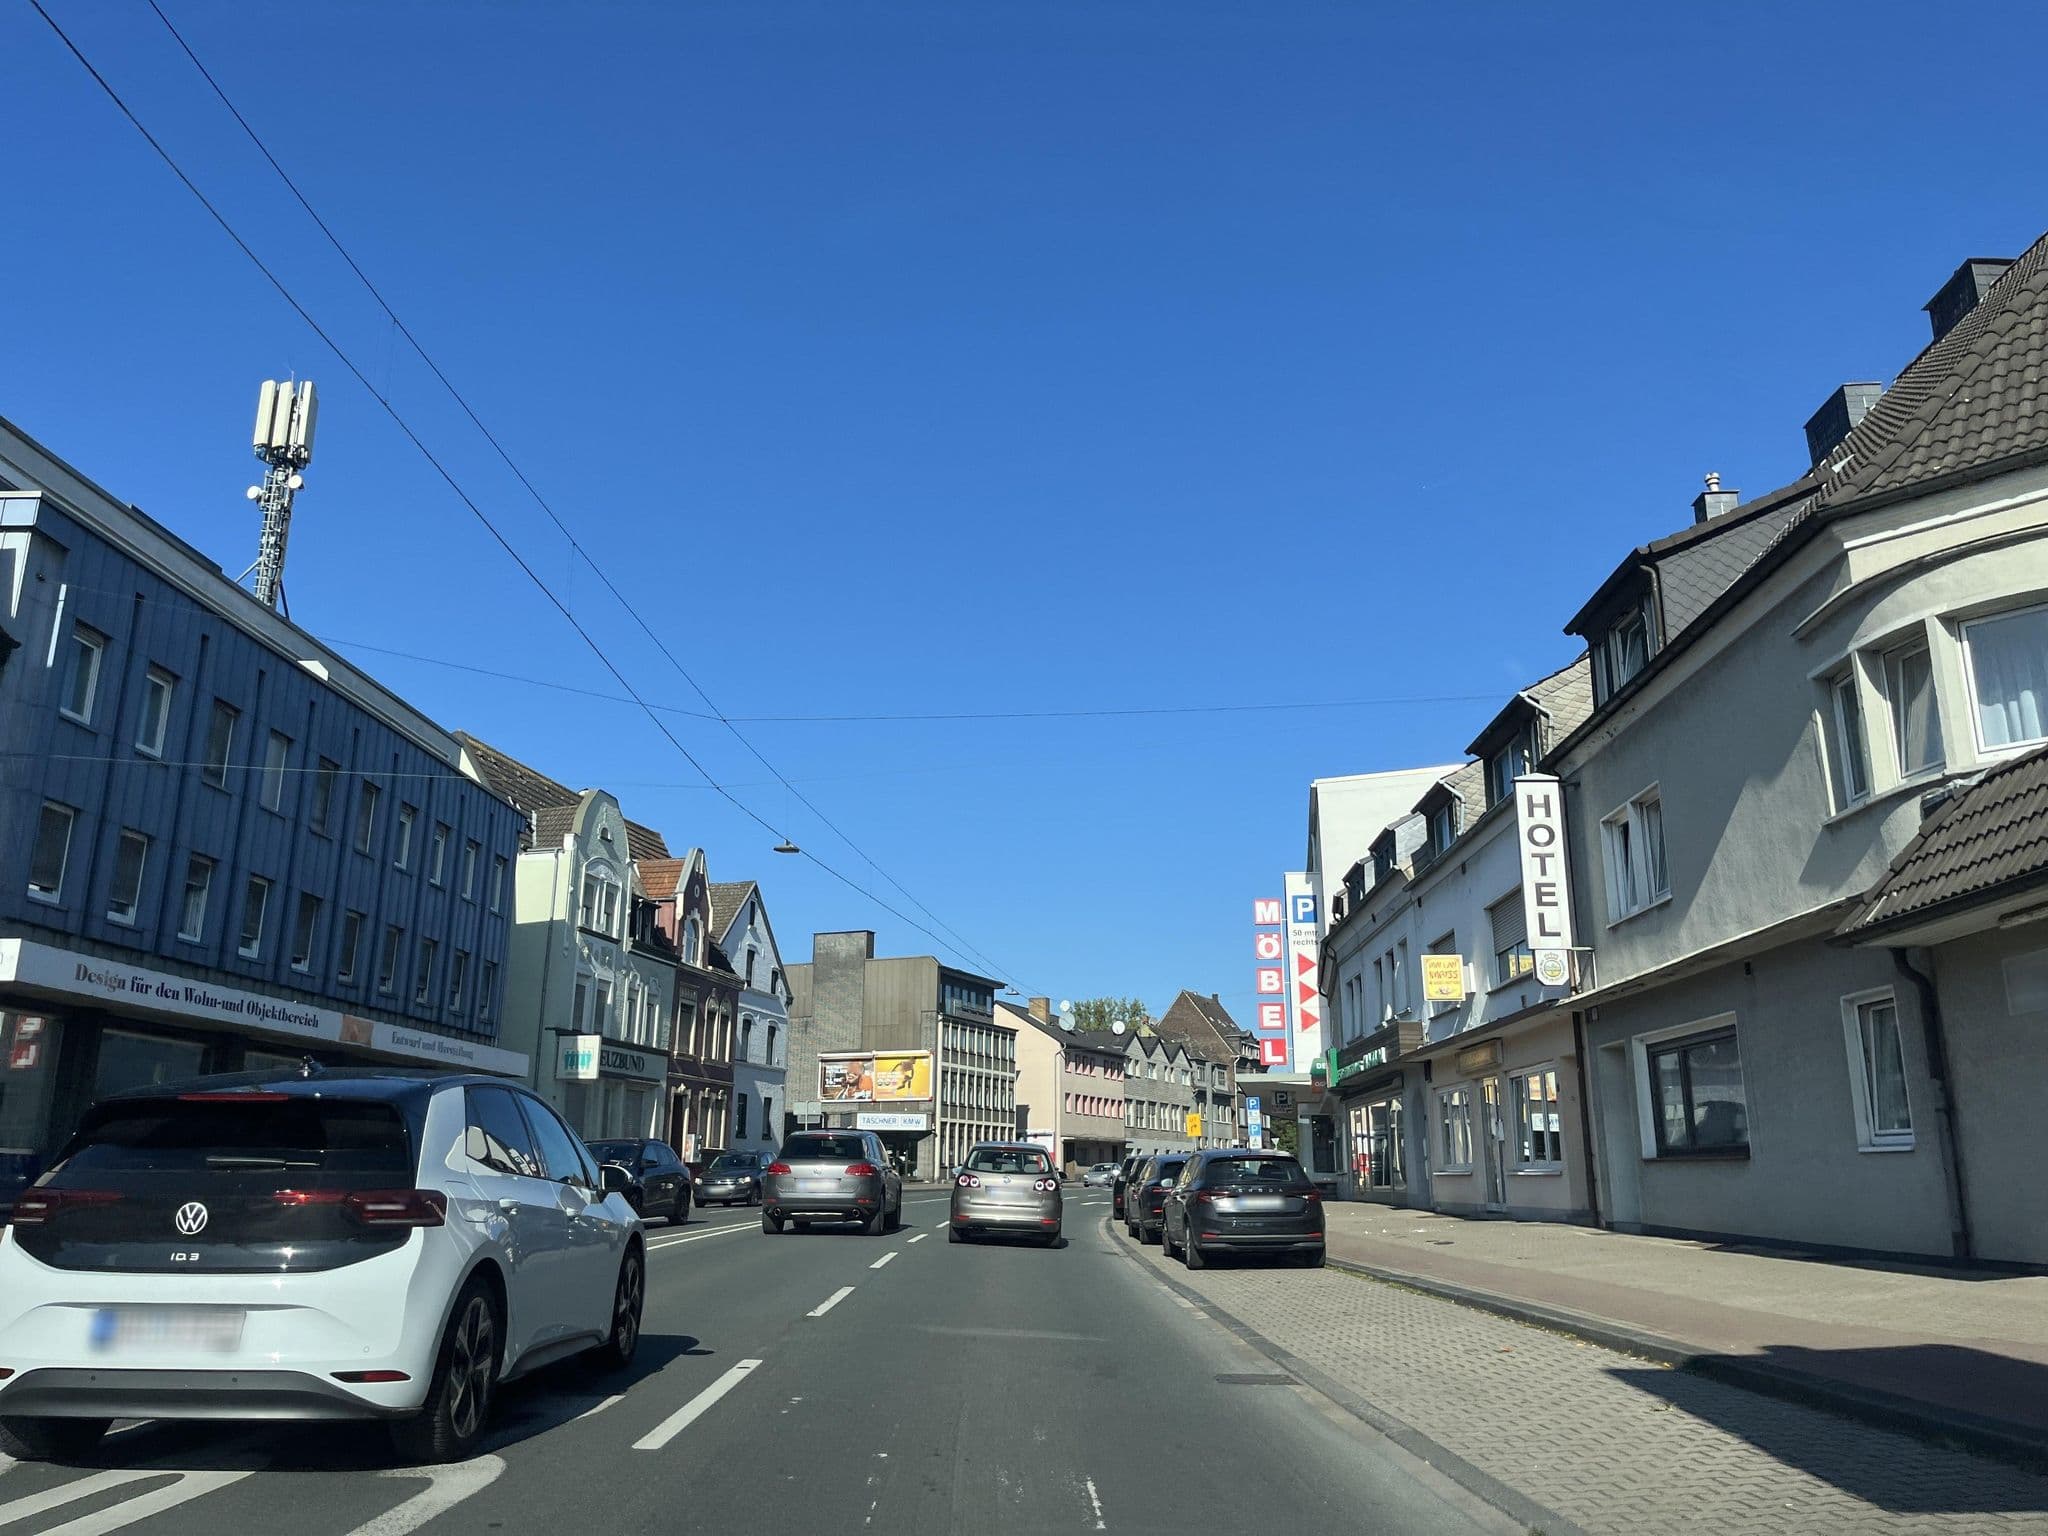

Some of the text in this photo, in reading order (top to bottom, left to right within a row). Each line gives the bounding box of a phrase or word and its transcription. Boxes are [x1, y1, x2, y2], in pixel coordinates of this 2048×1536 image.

[1297, 898, 1315, 920] P
[1526, 794, 1561, 937] HOTEL
[74, 963, 126, 993] Design
[130, 976, 153, 995] für
[155, 982, 180, 1001] den
[246, 999, 320, 1029] Objektbereich
[1255, 900, 1284, 1063] MÖBEL
